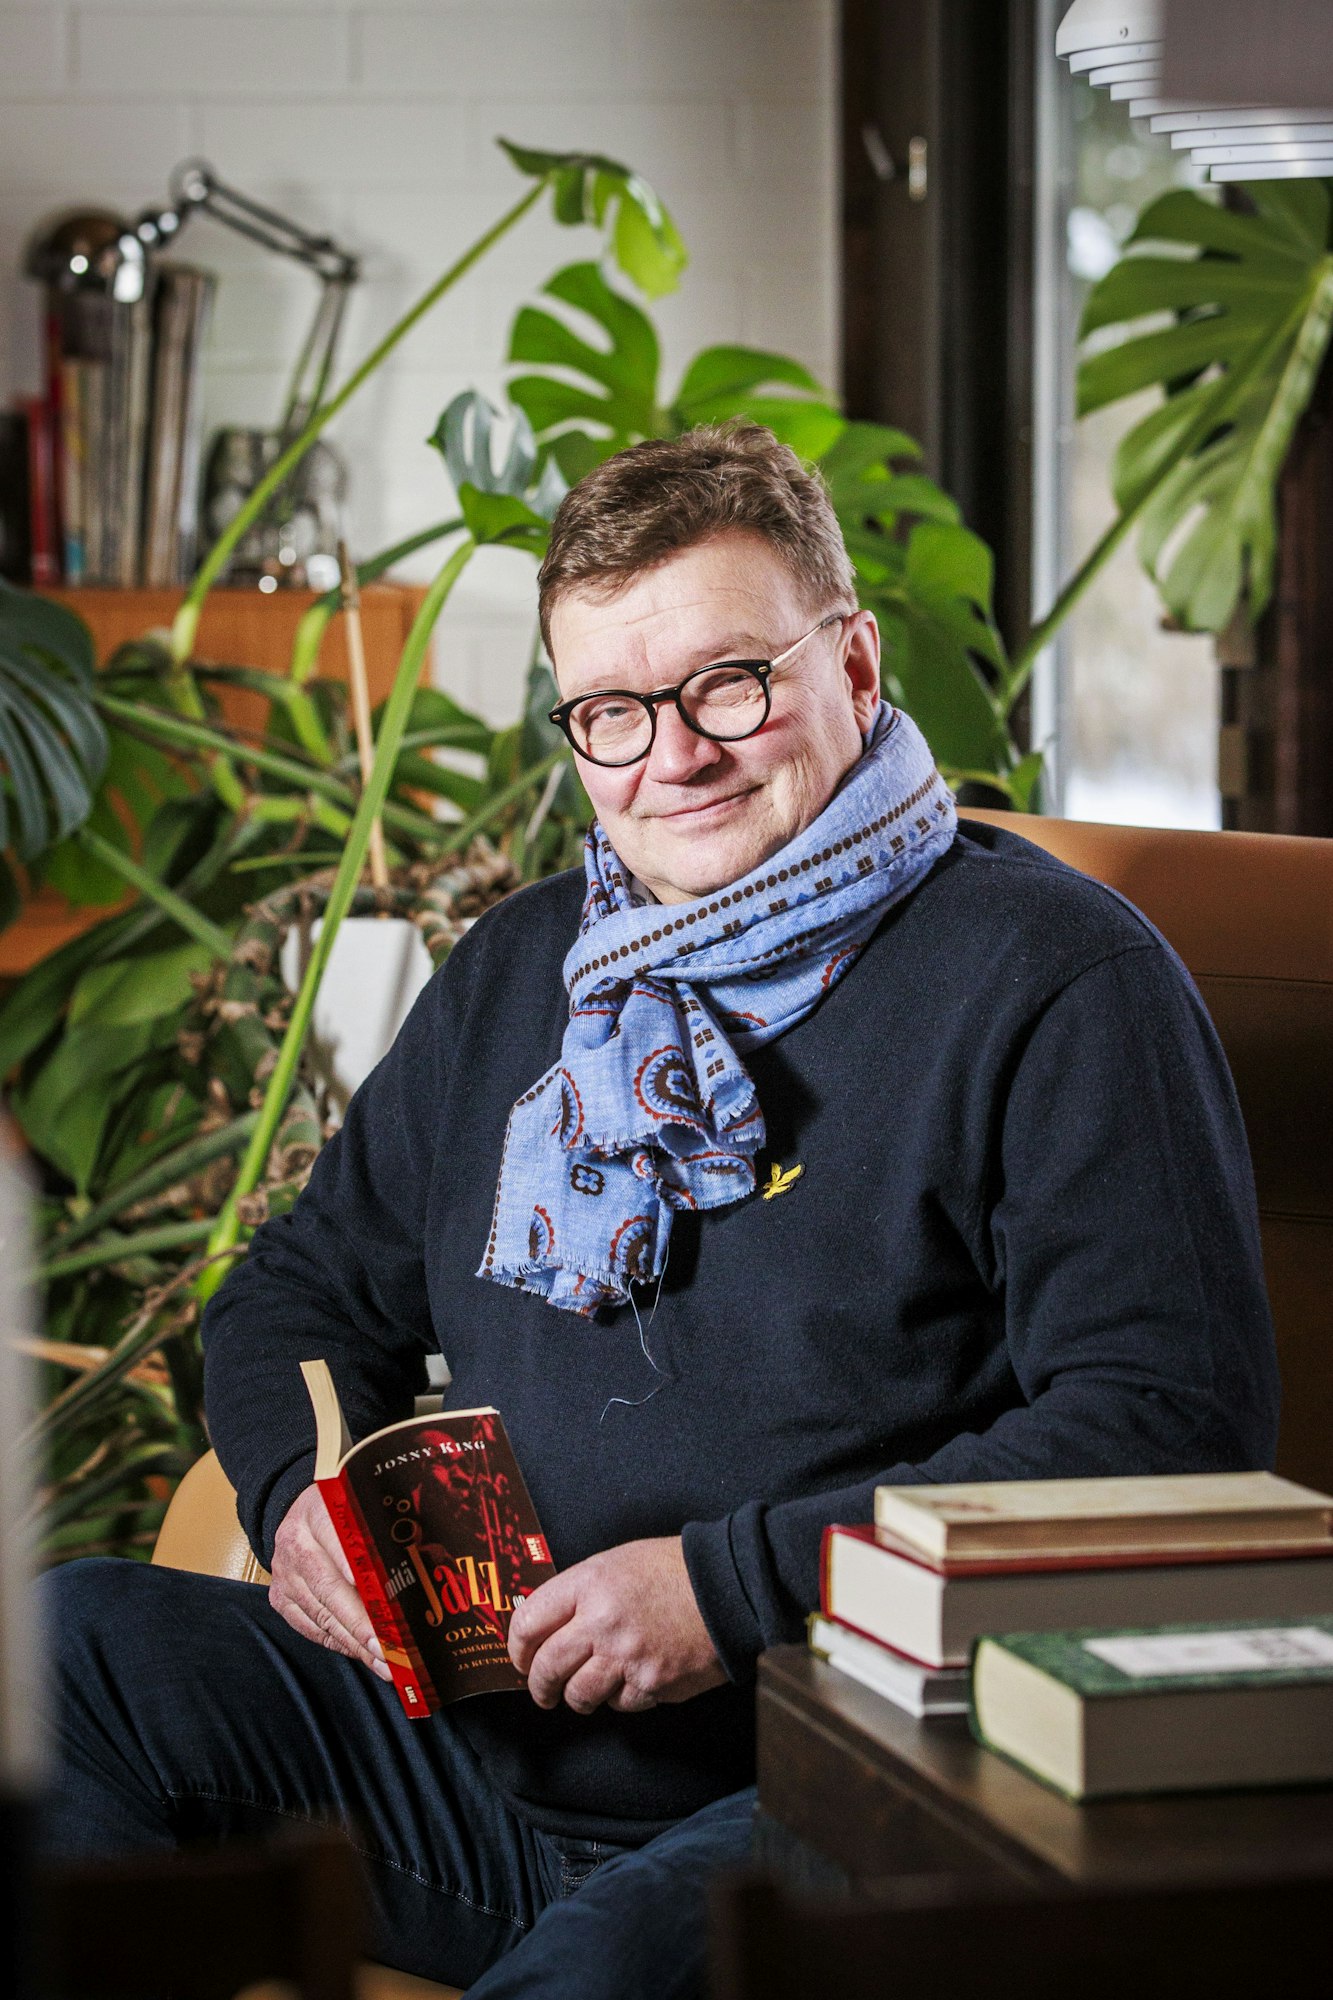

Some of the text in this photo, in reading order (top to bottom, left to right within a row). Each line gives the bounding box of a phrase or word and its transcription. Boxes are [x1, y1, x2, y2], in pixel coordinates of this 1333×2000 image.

[374, 1440, 486, 1476] JONNY KING
[526, 1537, 540, 1561] LIKE
[385, 1560, 416, 1600] mitä
[445, 1623, 498, 1643] OPAS
[405, 1686, 417, 1704] LIKE
